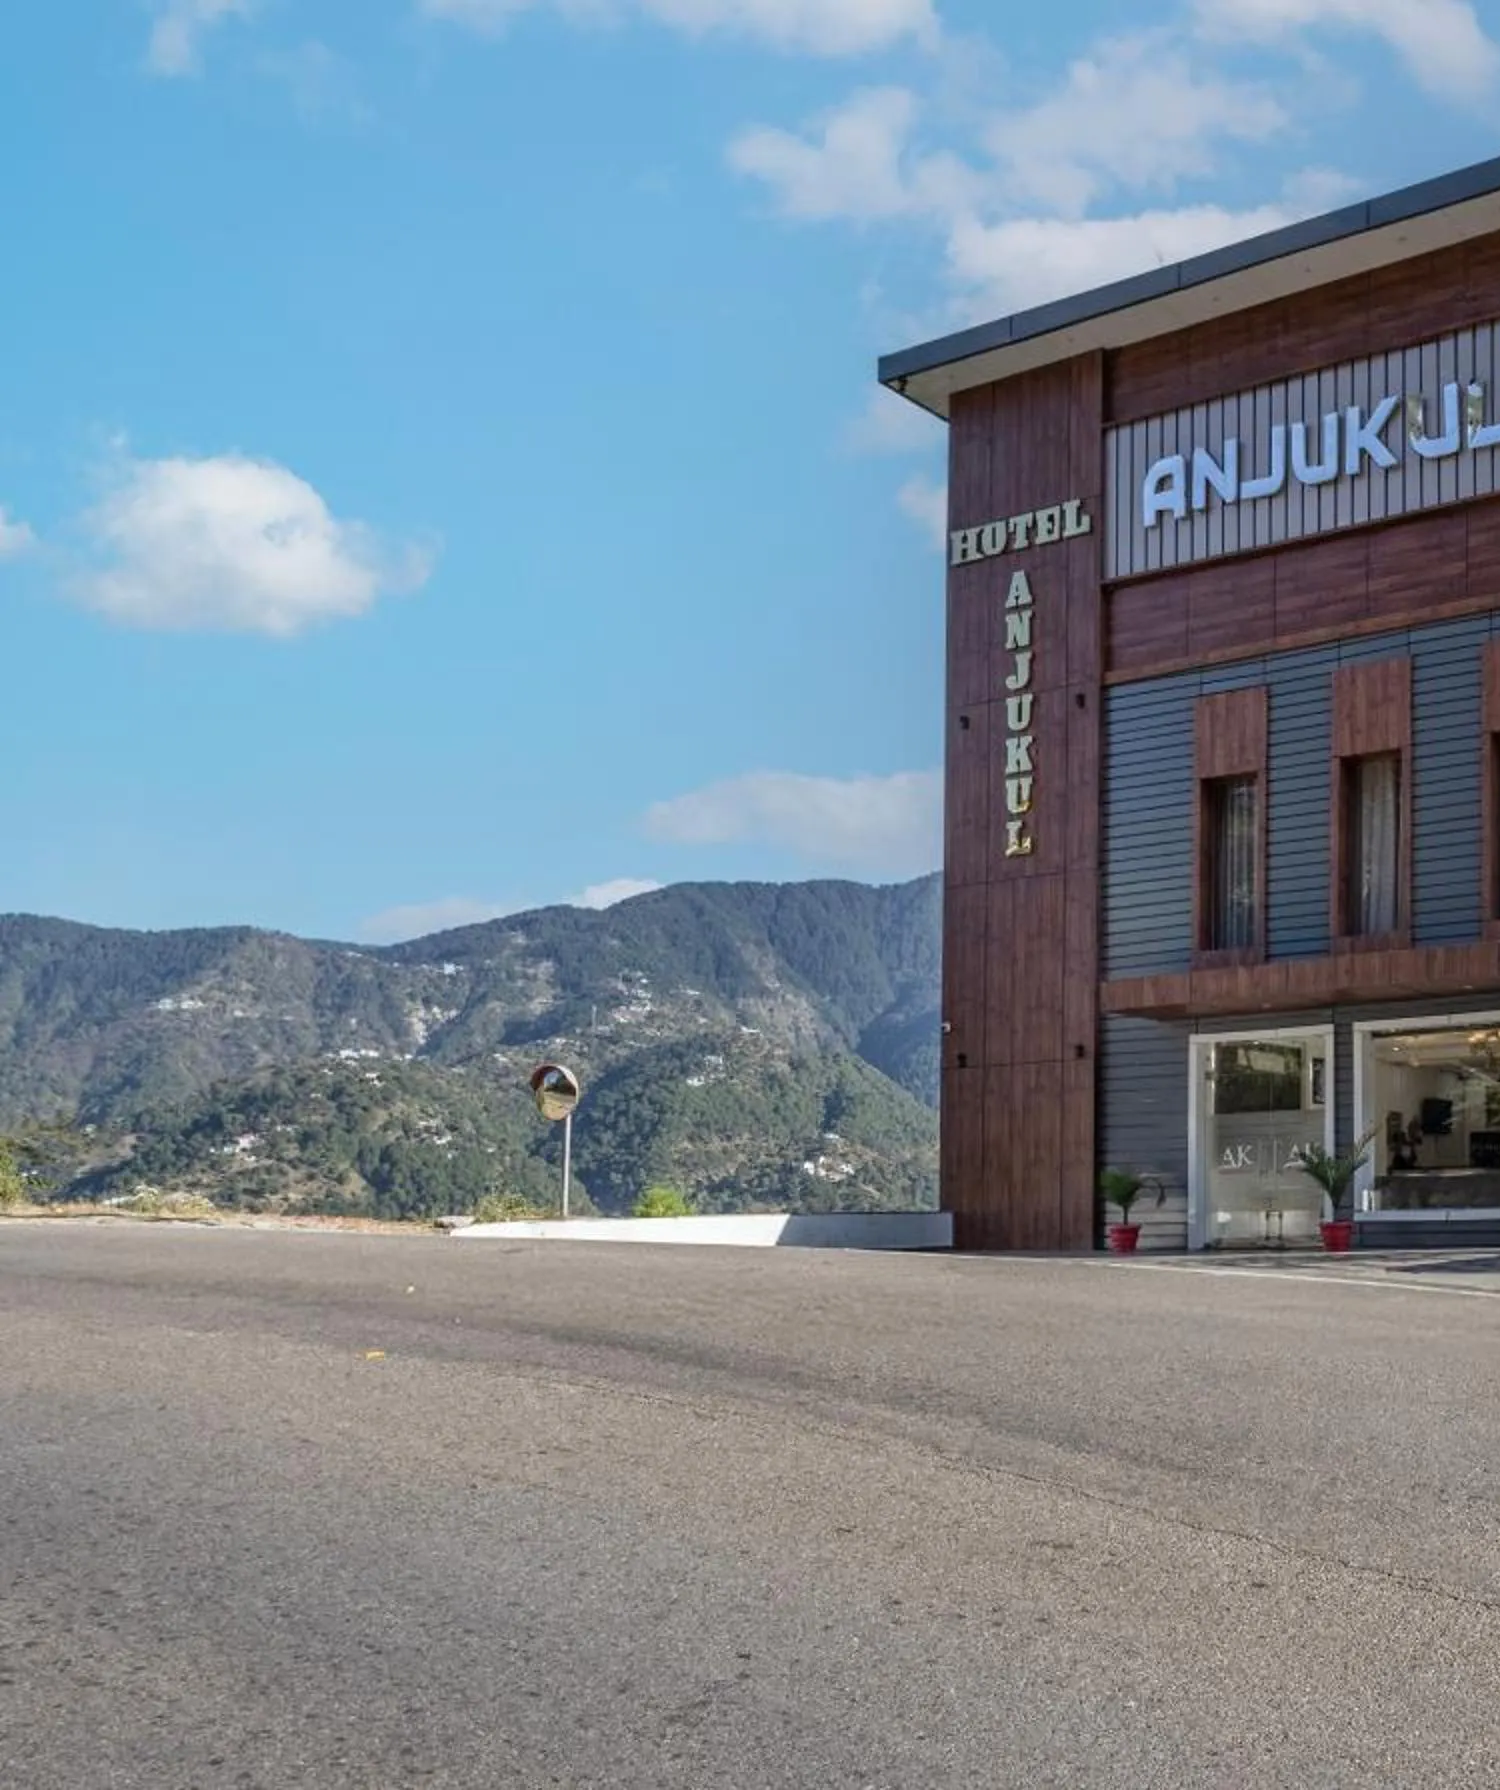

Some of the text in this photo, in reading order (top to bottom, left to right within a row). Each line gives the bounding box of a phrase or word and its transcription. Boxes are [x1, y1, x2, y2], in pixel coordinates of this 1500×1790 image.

[950, 499, 1091, 566] HOTEL
[1005, 570, 1034, 858] ANJUKUL
[1222, 1144, 1254, 1169] AK
